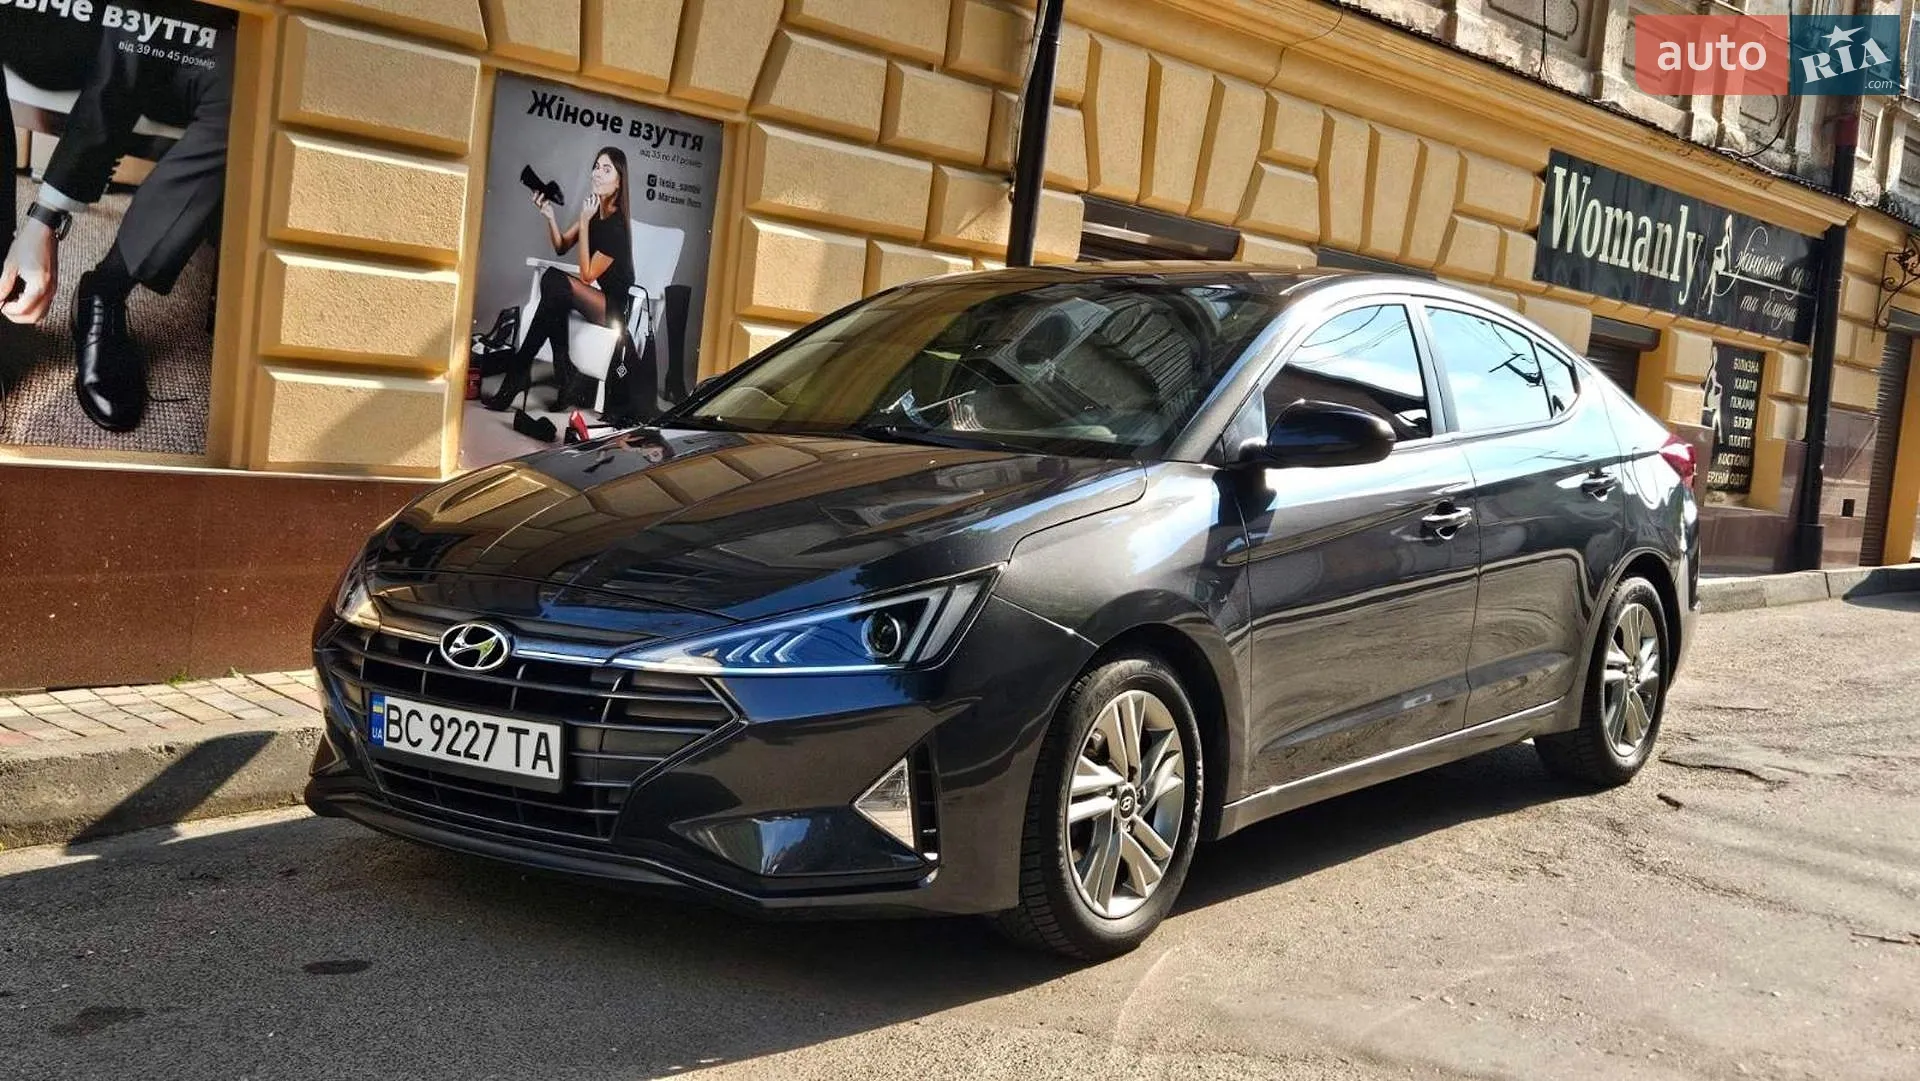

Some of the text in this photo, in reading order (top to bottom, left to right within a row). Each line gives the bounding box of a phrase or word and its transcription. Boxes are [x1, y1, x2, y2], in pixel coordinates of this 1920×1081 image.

[102, 5, 218, 49] взуття
[118, 41, 215, 70] від 39 по 45 розмір
[527, 90, 704, 152] Жіноче взуття
[1552, 165, 1704, 306] Womanly
[372, 727, 383, 739] UA
[386, 704, 554, 773] BC 9227 TA
